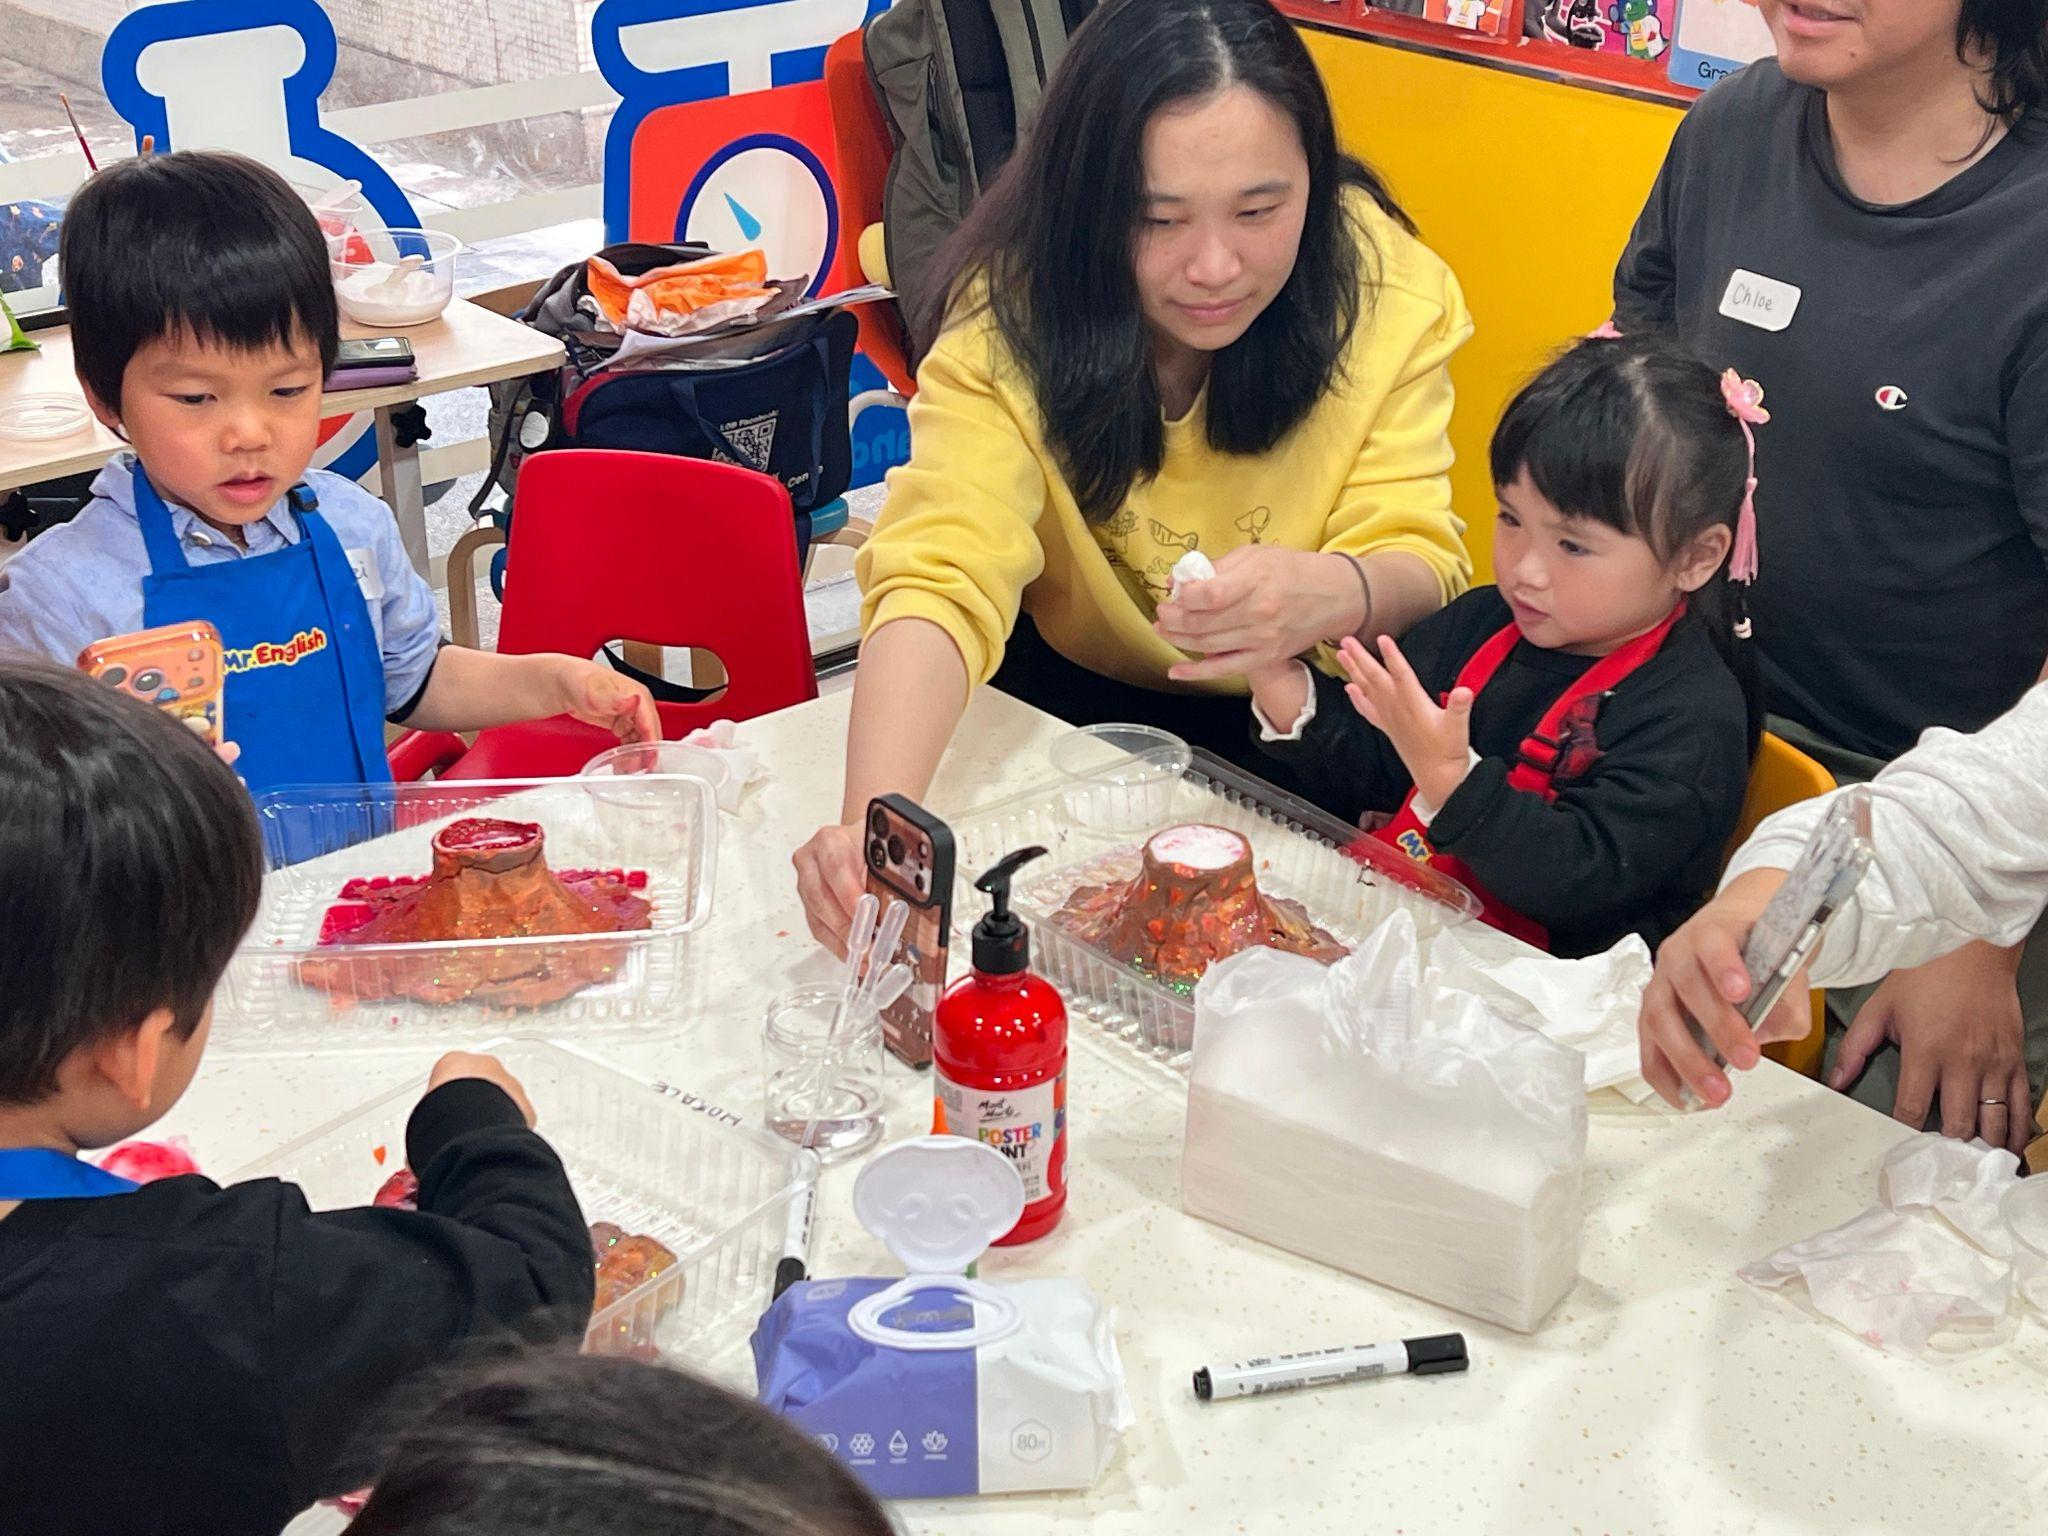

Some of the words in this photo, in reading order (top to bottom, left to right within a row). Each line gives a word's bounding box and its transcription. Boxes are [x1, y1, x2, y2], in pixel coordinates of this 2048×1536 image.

[1732, 283, 1774, 311] Chloe
[978, 1122, 1042, 1145] POSTER
[992, 1142, 1027, 1159] INT
